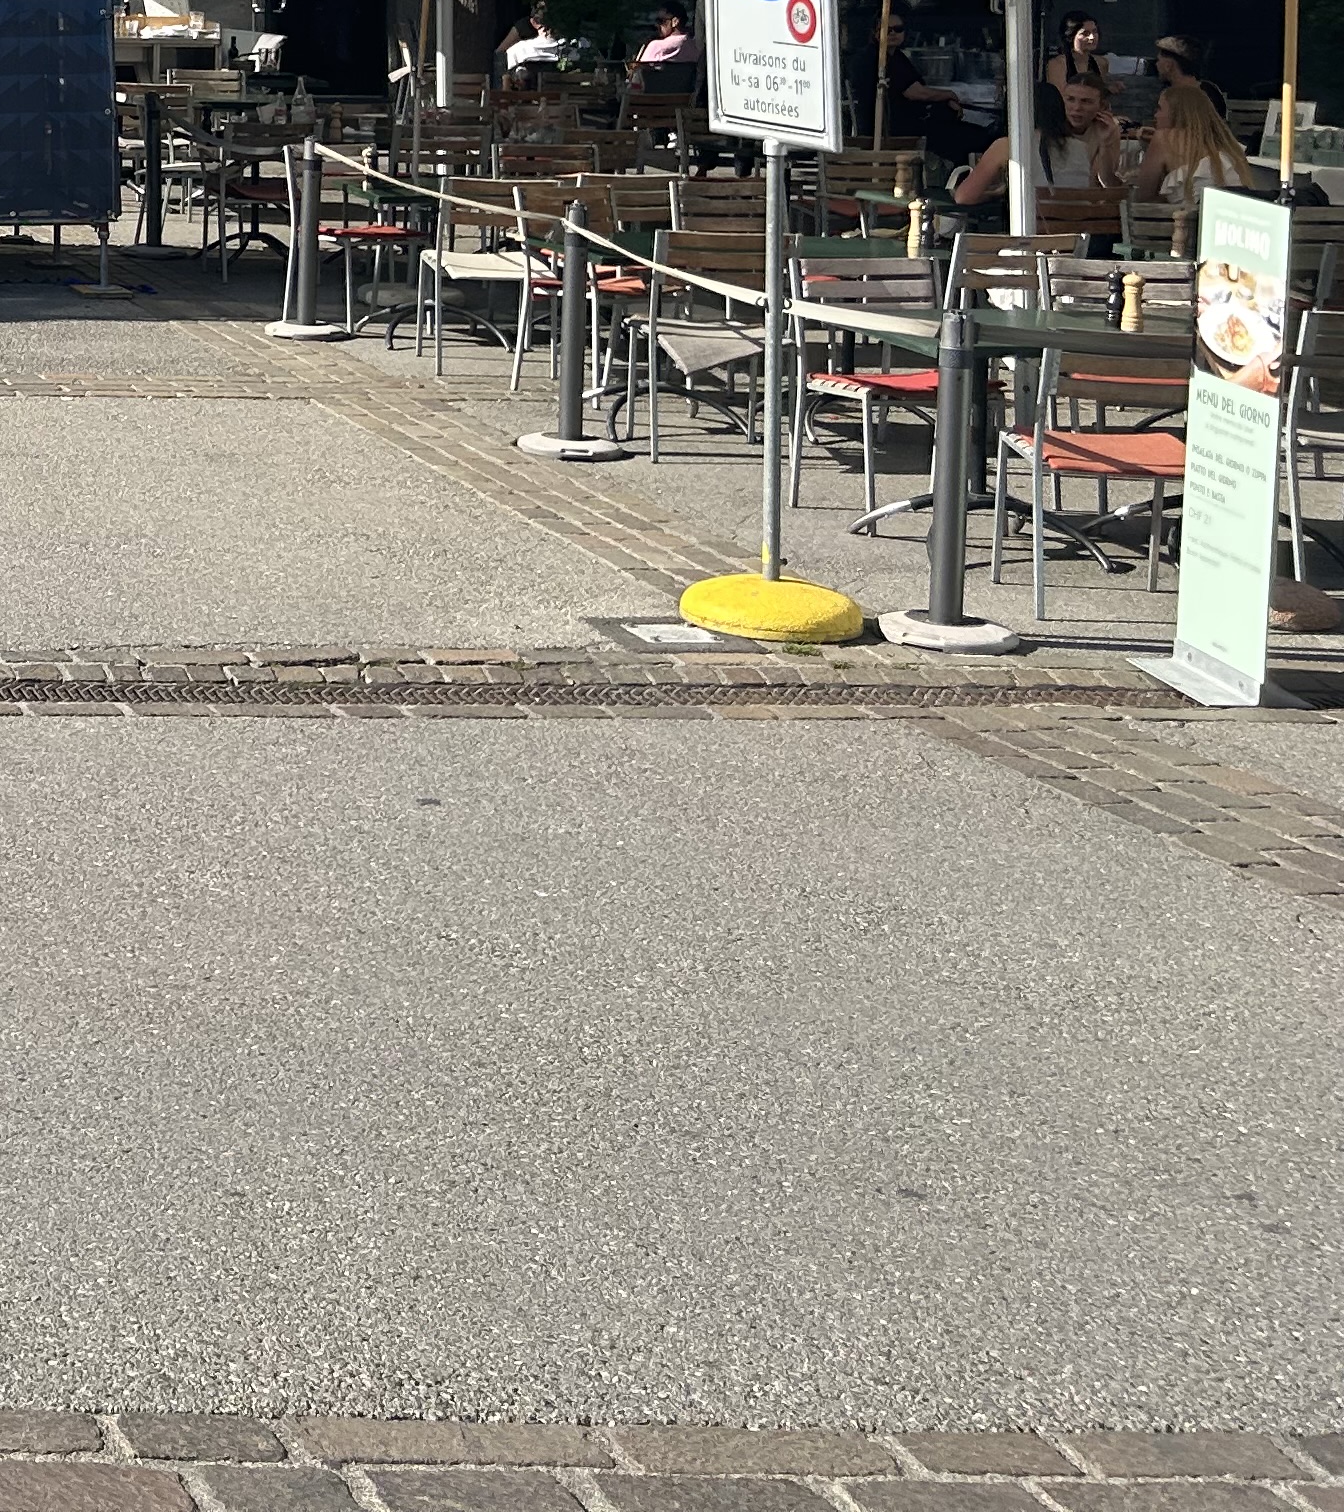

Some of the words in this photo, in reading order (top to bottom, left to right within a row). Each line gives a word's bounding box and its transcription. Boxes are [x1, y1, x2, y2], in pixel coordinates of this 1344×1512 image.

[733, 47, 787, 70] Livraisons
[792, 56, 806, 72] du
[743, 98, 800, 119] autorisées
[1214, 219, 1271, 261] MOLINO
[1196, 388, 1219, 408] MENU
[1221, 396, 1235, 416] DEL
[1239, 403, 1271, 428] GIORNO
